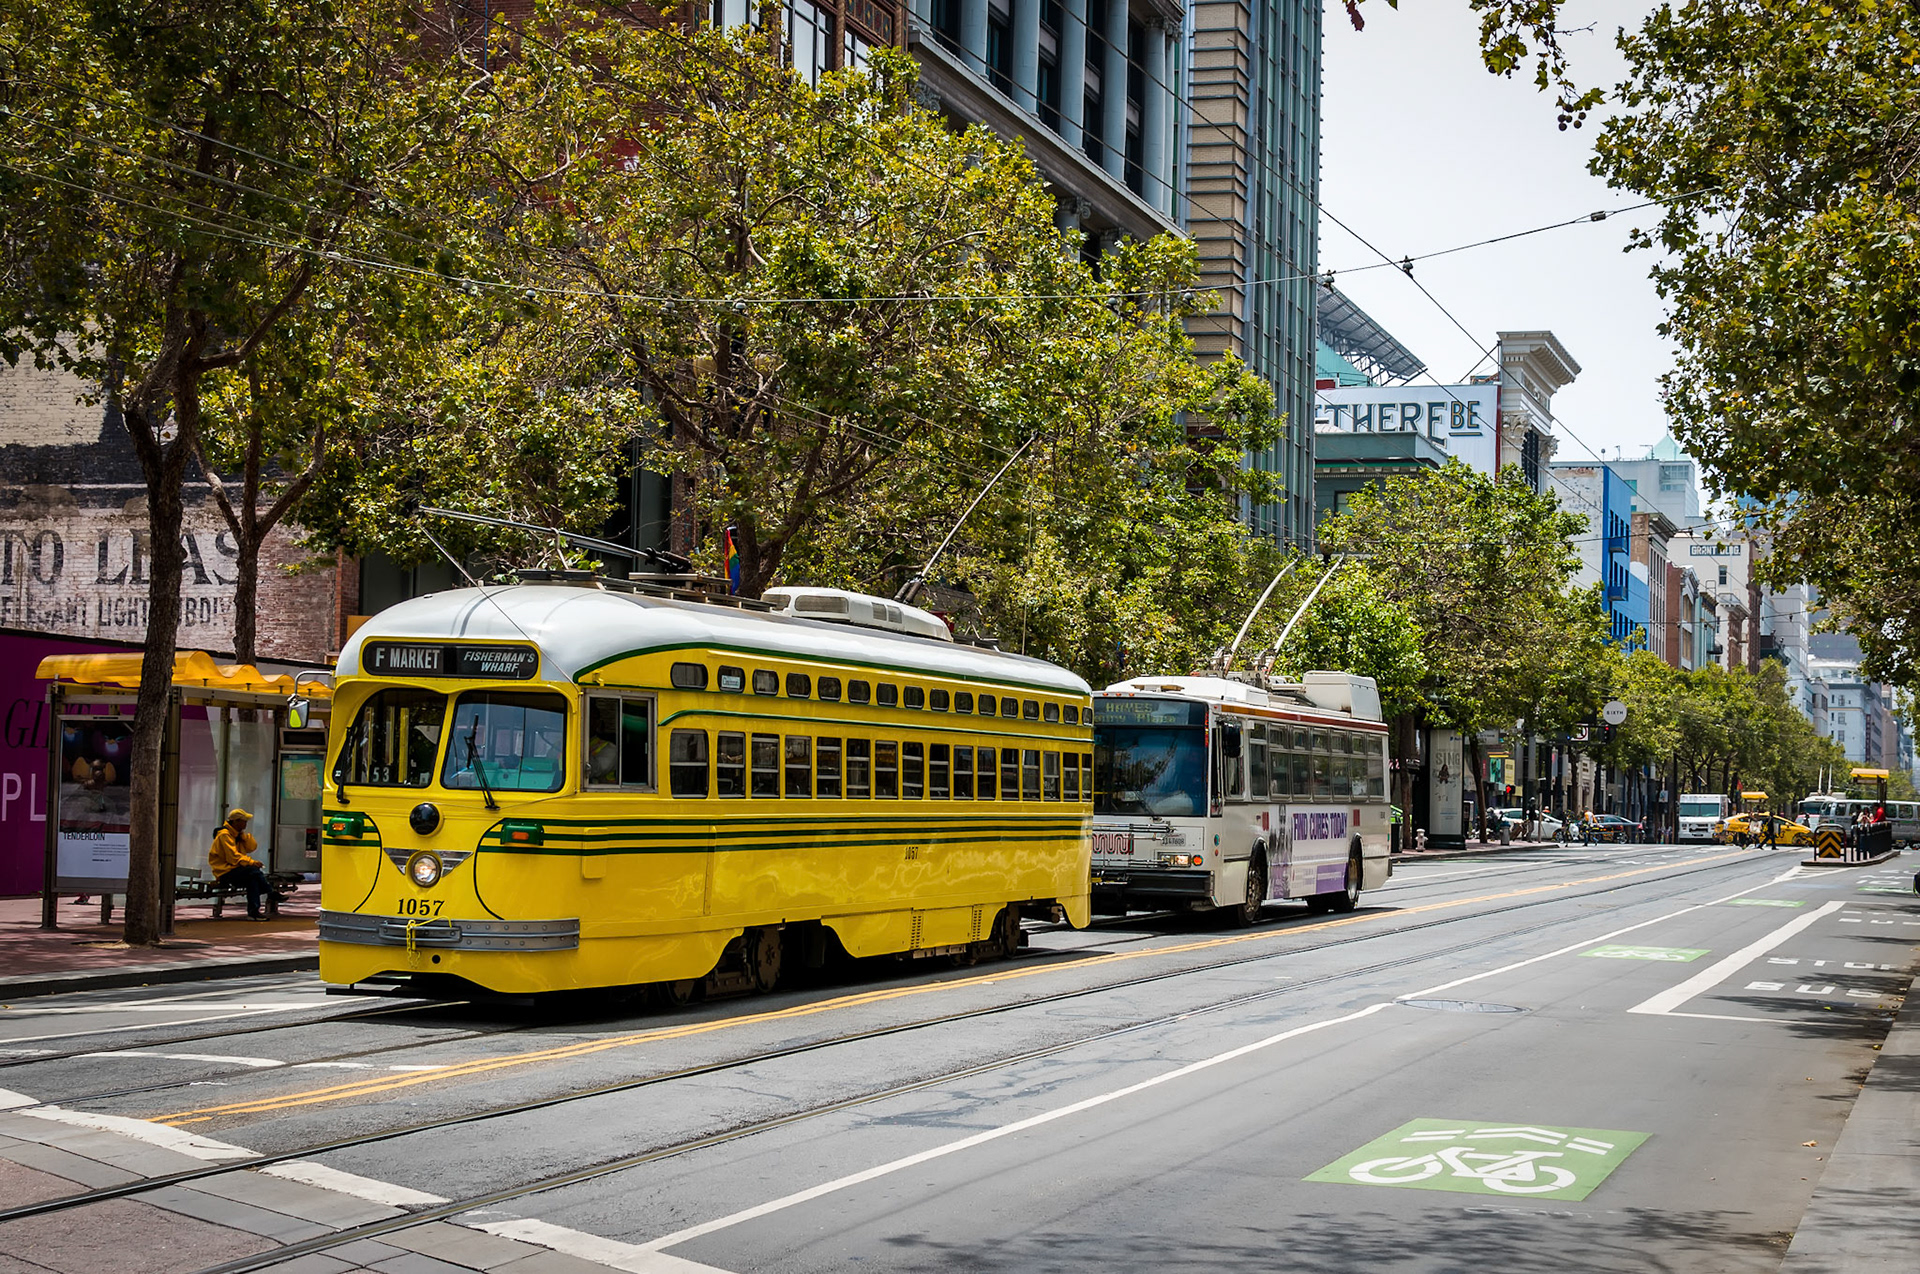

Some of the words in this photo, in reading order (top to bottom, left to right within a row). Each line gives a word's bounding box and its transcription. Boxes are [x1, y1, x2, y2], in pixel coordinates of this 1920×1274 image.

[375, 648, 385, 667] F
[390, 648, 440, 669] MARKET
[463, 651, 535, 663] FISHERMAN'S
[481, 662, 519, 673] WHARF
[1106, 702, 1153, 713] HAYES
[1435, 752, 1461, 766] SING
[1310, 813, 1329, 840] CURES
[1330, 812, 1347, 839] TODAY
[397, 898, 445, 917] 1057
[1744, 981, 1884, 998] BUS
